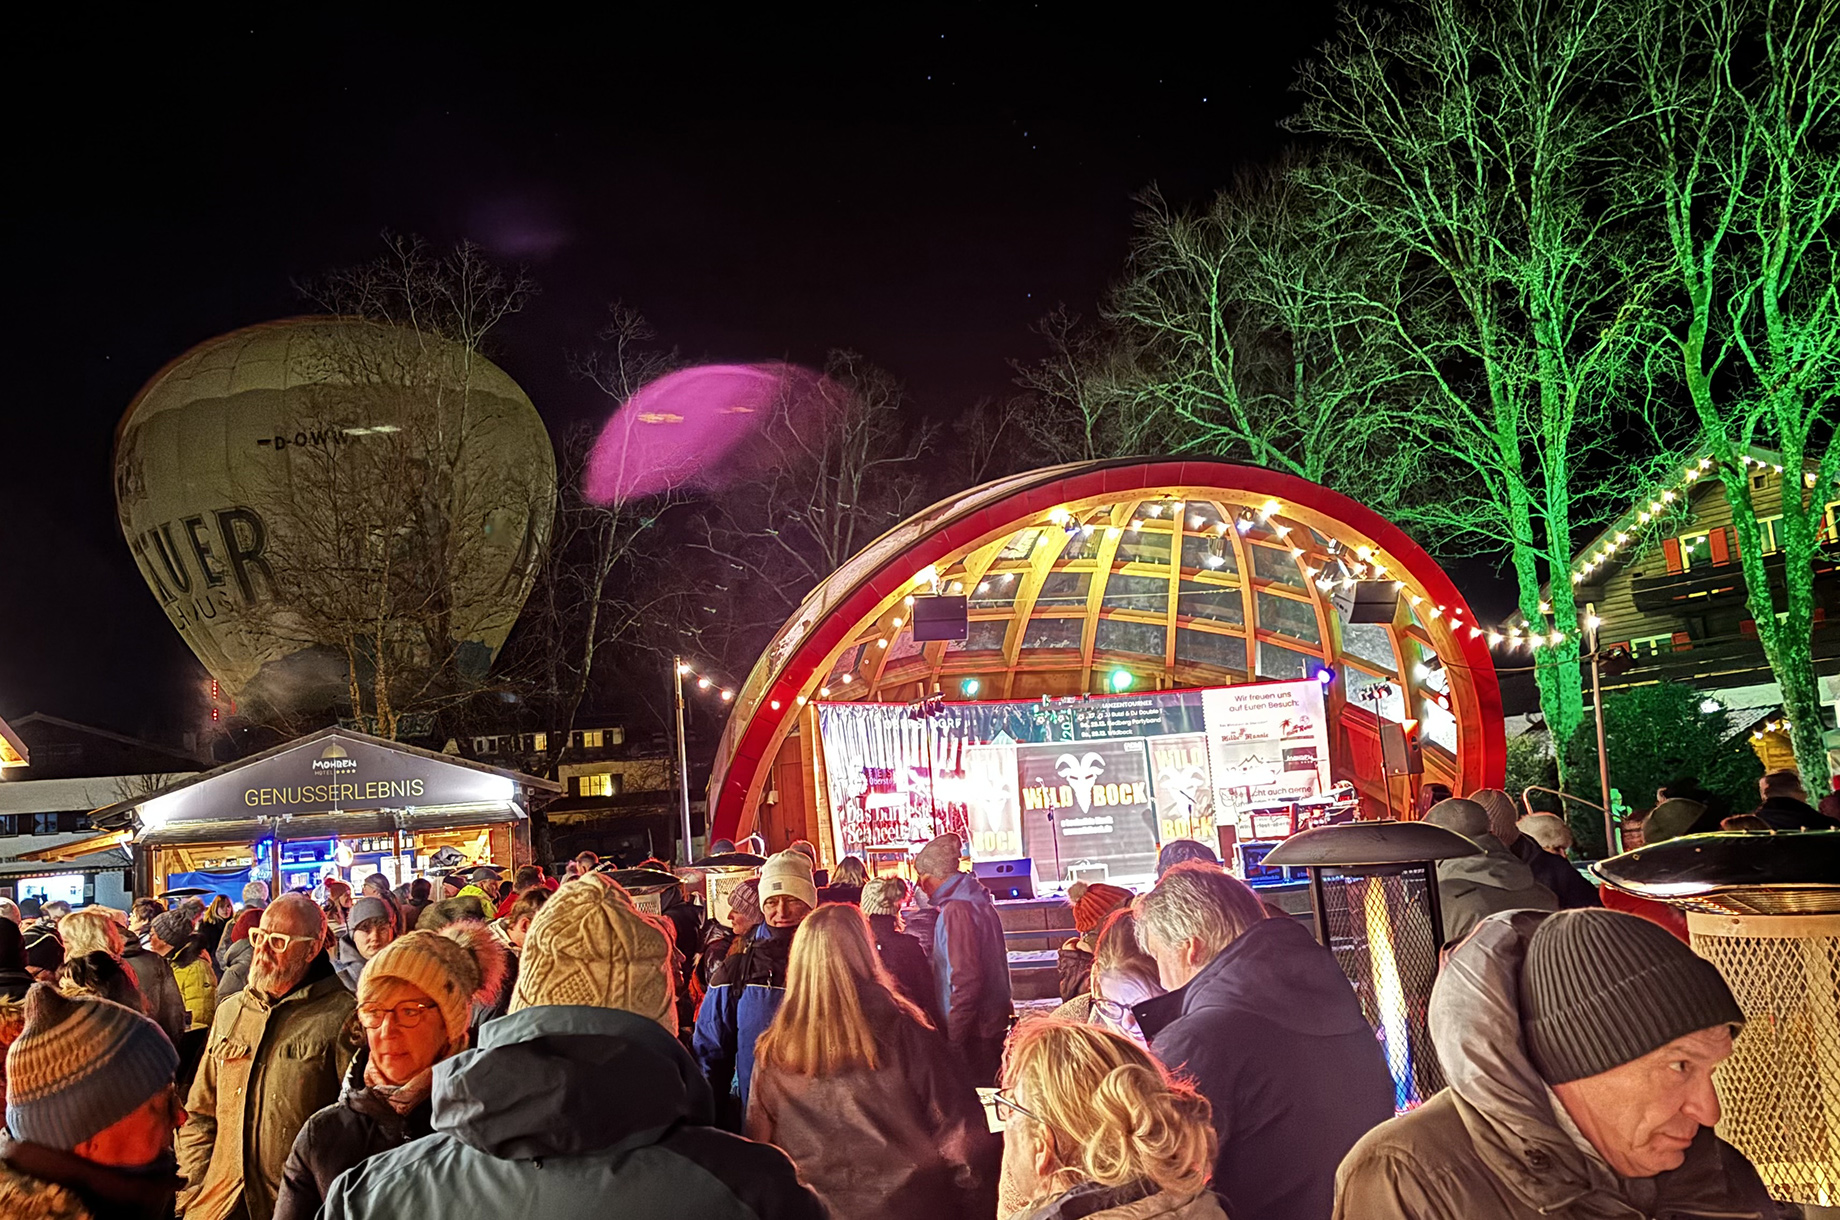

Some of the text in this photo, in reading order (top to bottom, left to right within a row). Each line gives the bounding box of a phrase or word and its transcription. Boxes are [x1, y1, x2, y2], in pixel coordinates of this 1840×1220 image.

[1249, 693, 1276, 702] freuen
[1277, 691, 1292, 699] uns
[1229, 703, 1242, 712] auf
[1245, 702, 1267, 711] Euren
[312, 759, 357, 770] MOHREN
[1154, 747, 1204, 769] WILD
[244, 778, 424, 807] GENUSSERLEBNIS
[1022, 781, 1148, 811] WILD BOCK
[1267, 787, 1287, 796] auch
[1161, 815, 1215, 839] BOCK
